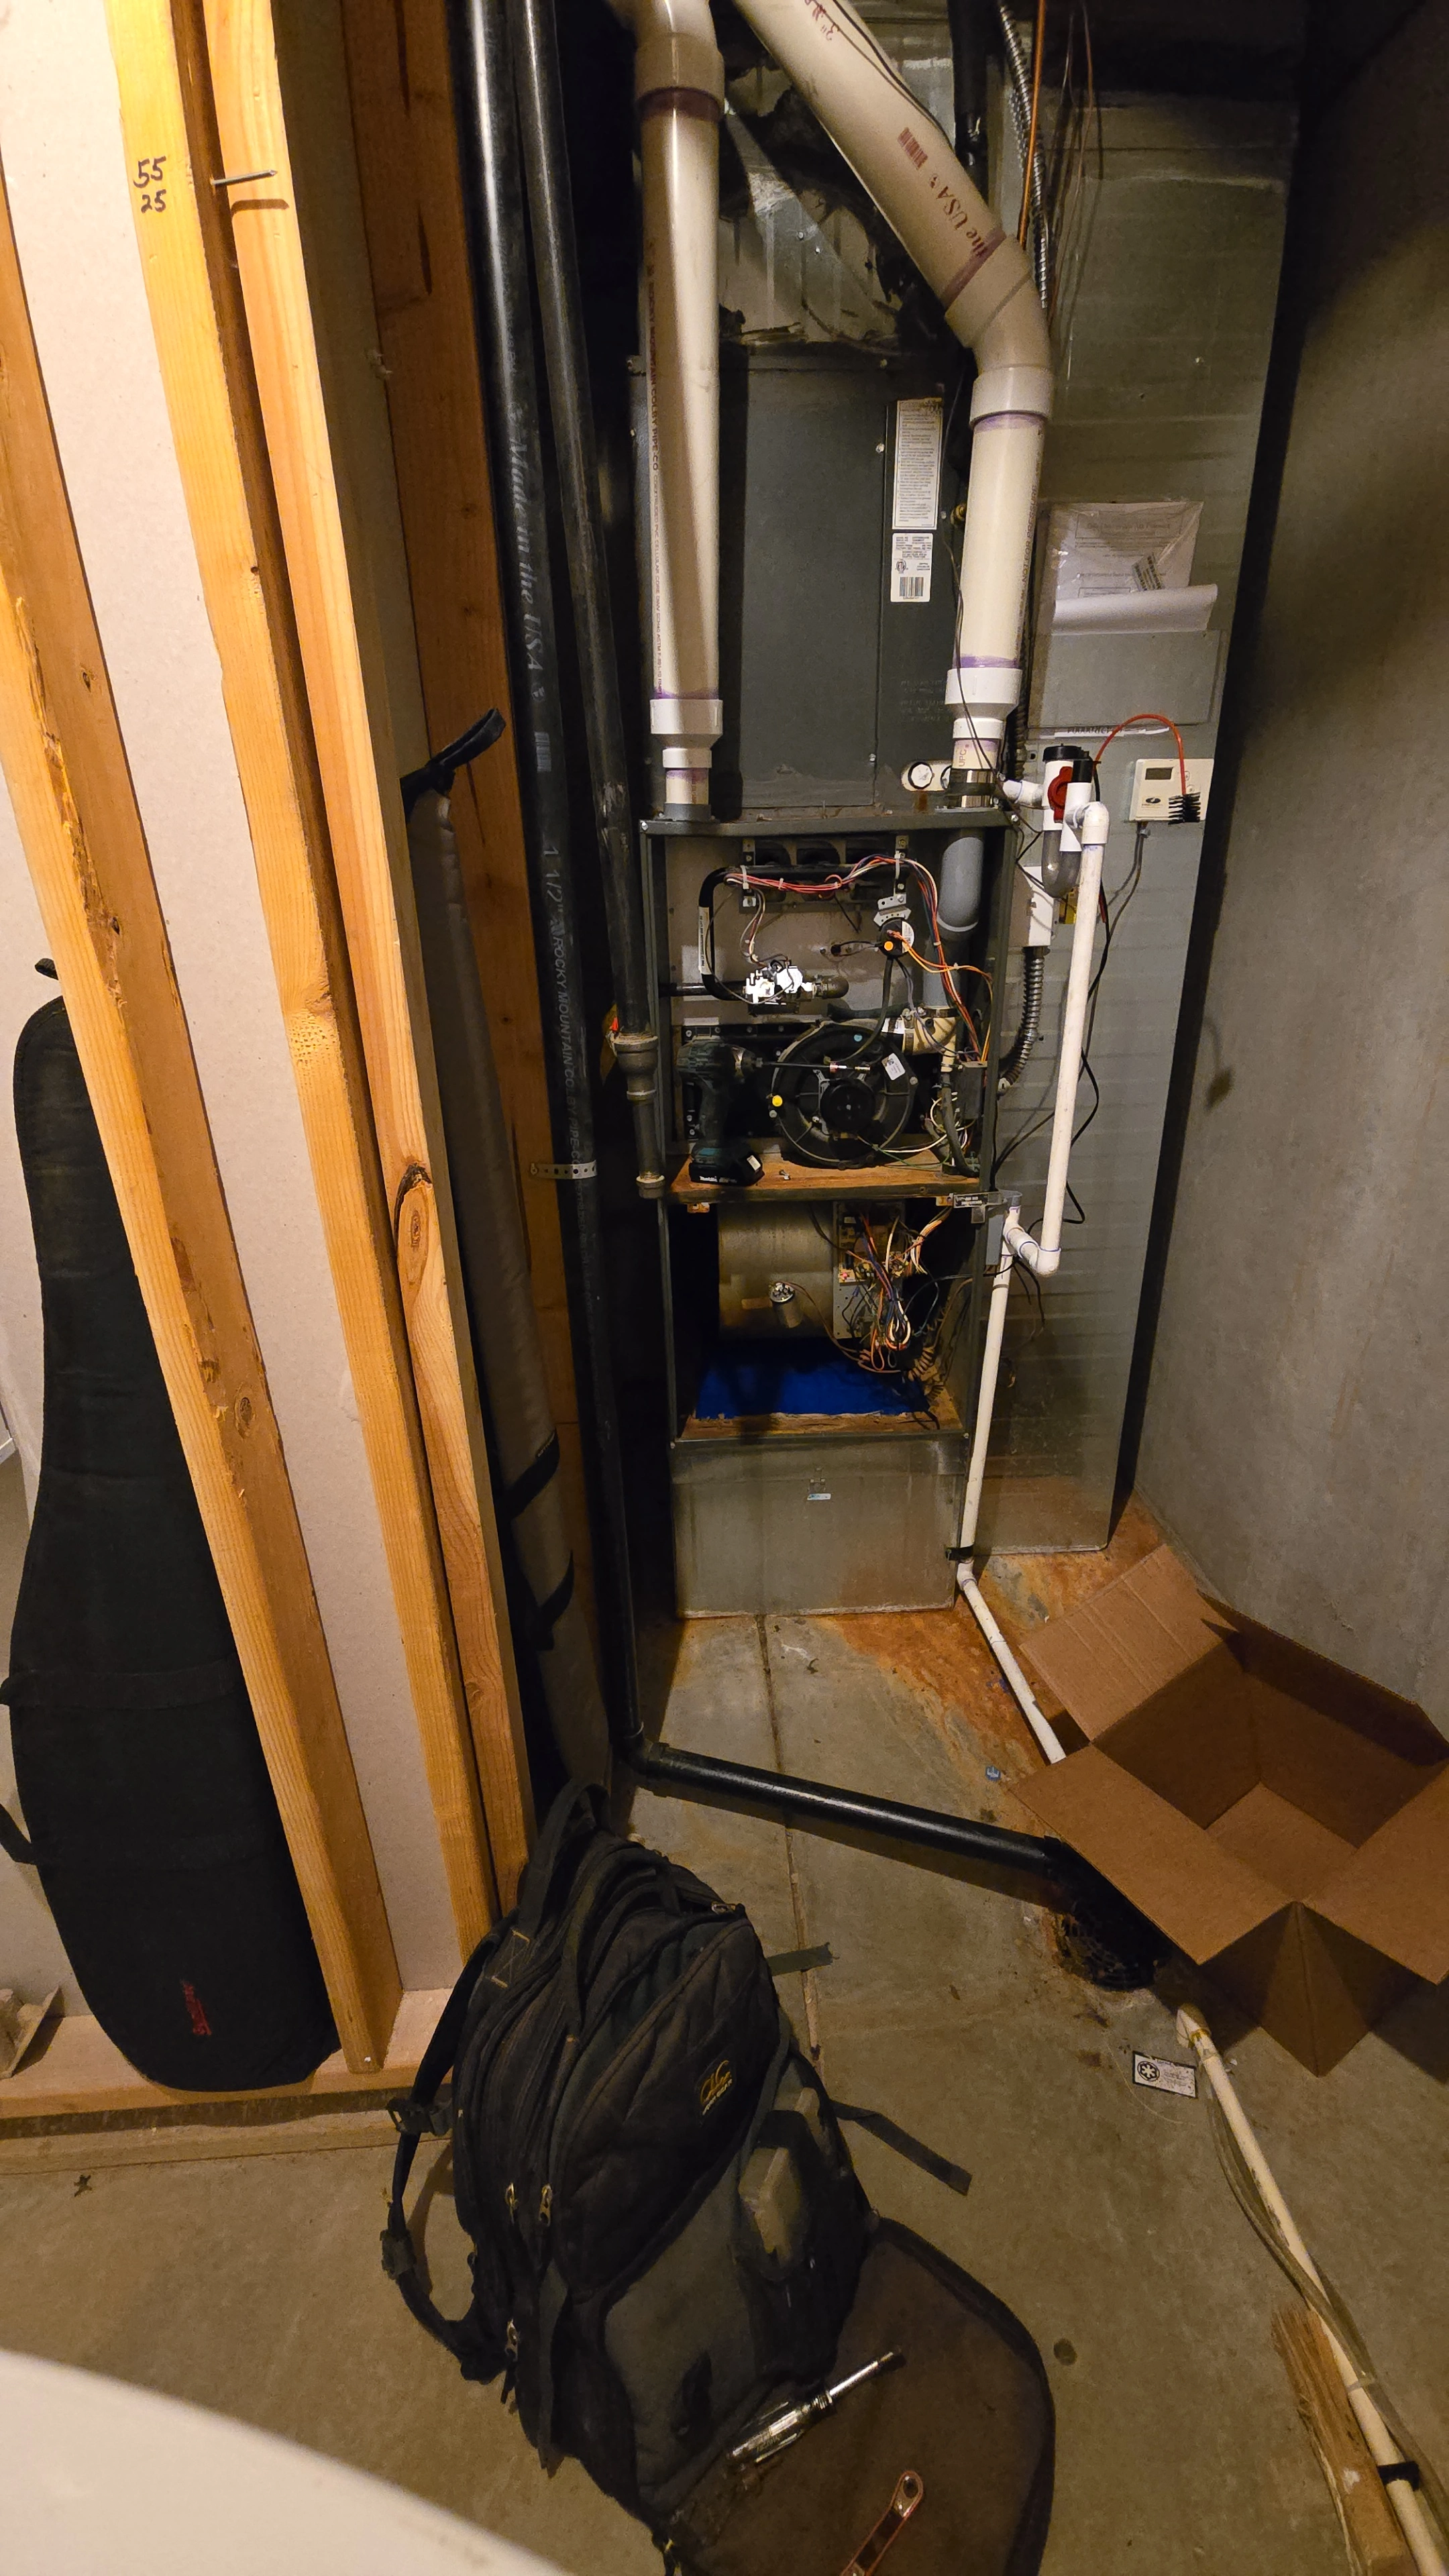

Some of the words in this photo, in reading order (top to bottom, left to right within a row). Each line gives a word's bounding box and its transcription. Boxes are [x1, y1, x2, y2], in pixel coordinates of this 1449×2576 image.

[133, 156, 166, 189] 55
[141, 189, 166, 213] 25
[935, 186, 968, 230] USA
[508, 437, 530, 515] Made
[516, 526, 533, 553] in
[518, 563, 539, 604] the
[523, 614, 544, 671] USA
[959, 749, 967, 767] UPC
[543, 845, 559, 857] 1
[545, 869, 564, 912] 1/2"
[553, 936, 568, 988] ROCKY
[557, 991, 574, 1066] MOUNTAIN
[564, 1069, 577, 1115] COLBY
